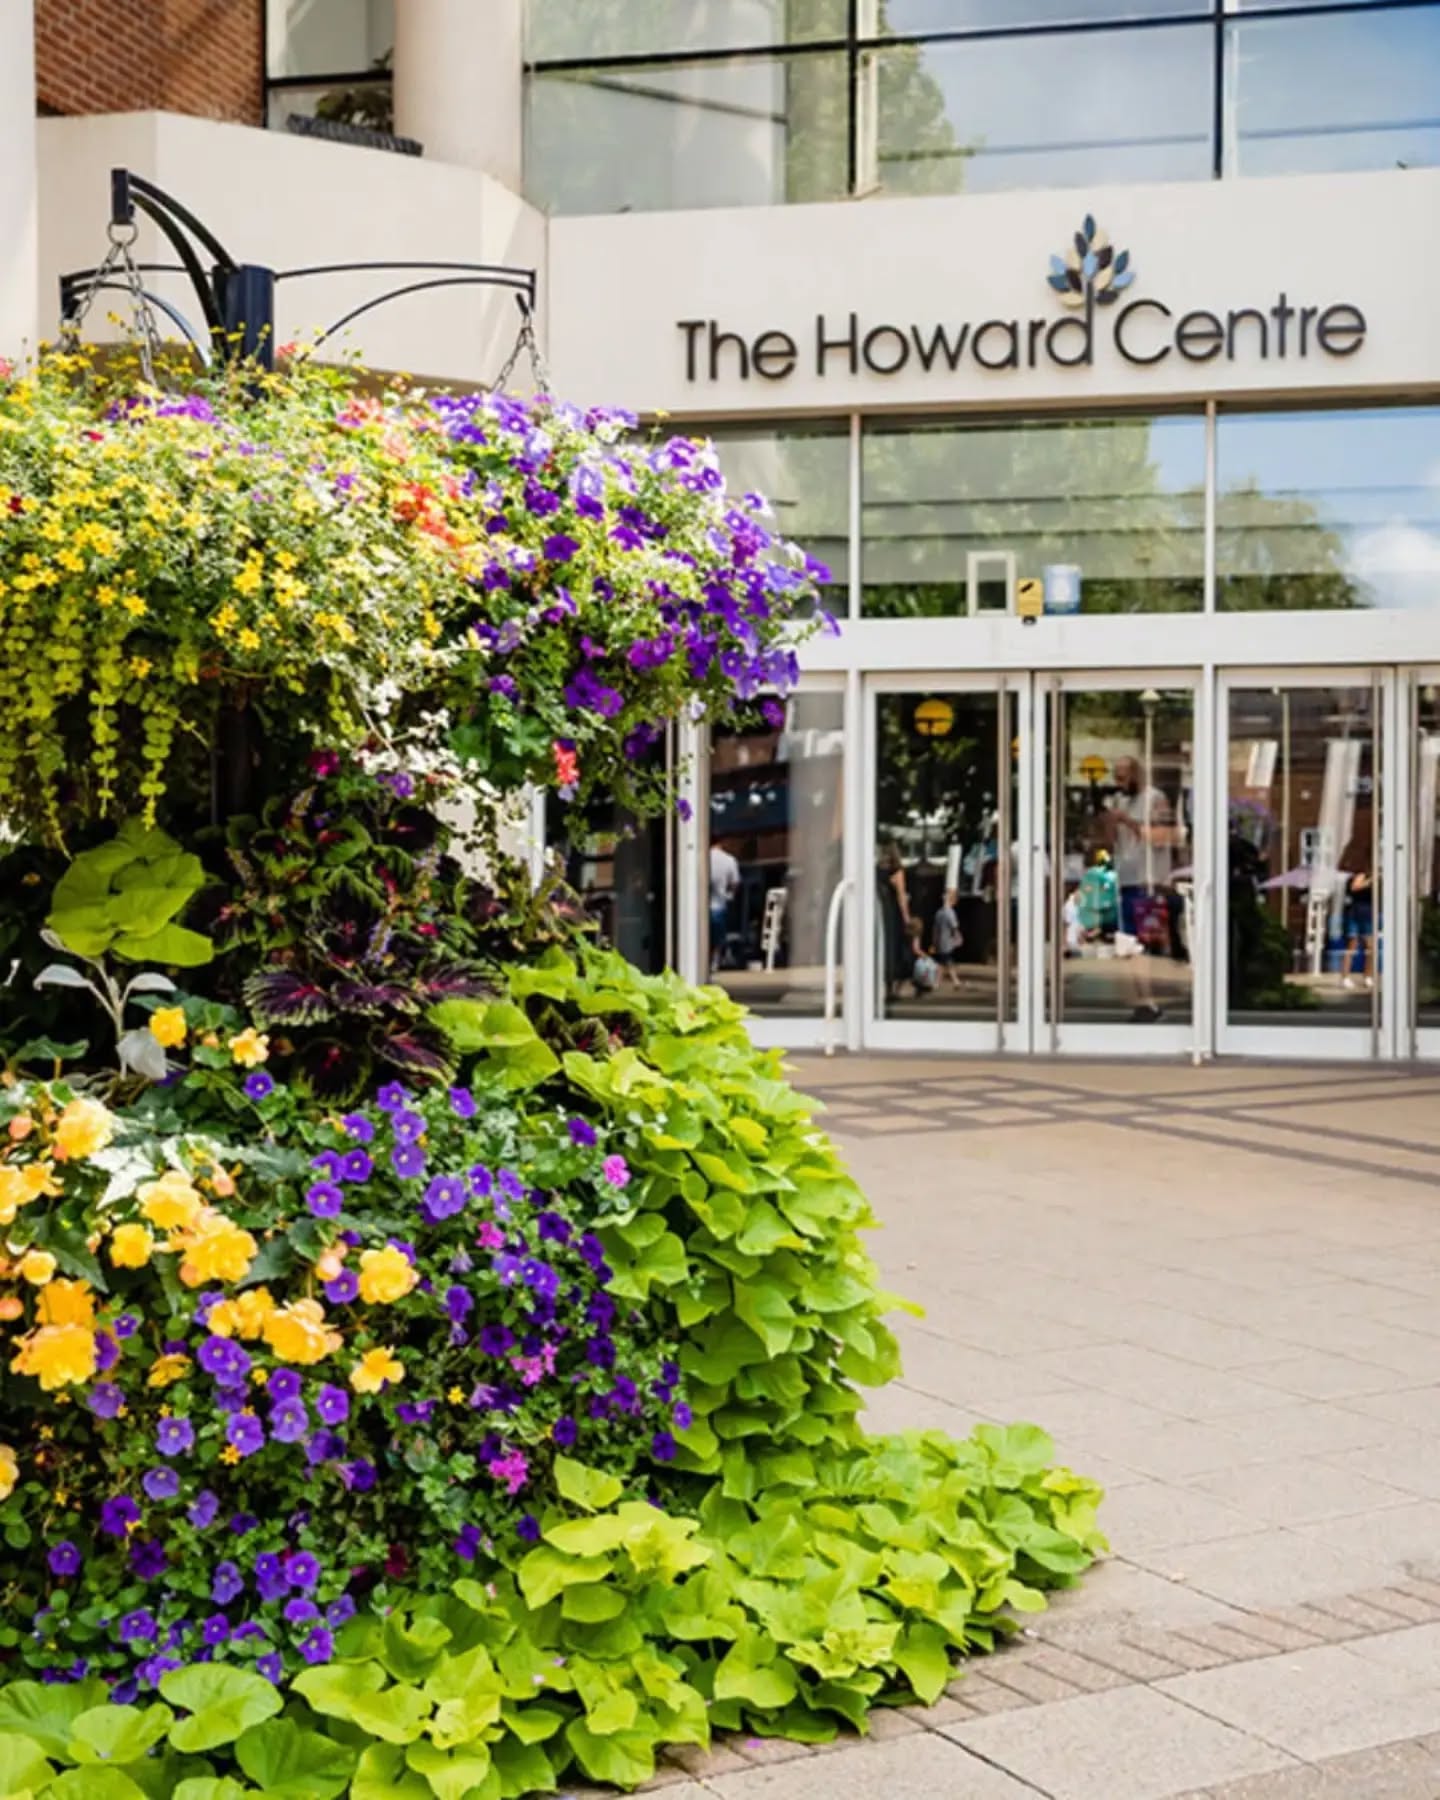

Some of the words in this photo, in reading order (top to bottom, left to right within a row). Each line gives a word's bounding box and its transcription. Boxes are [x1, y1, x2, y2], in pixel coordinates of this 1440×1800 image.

[676, 319, 798, 382] The
[816, 284, 1093, 377] Howard
[1114, 293, 1367, 365] Centre
